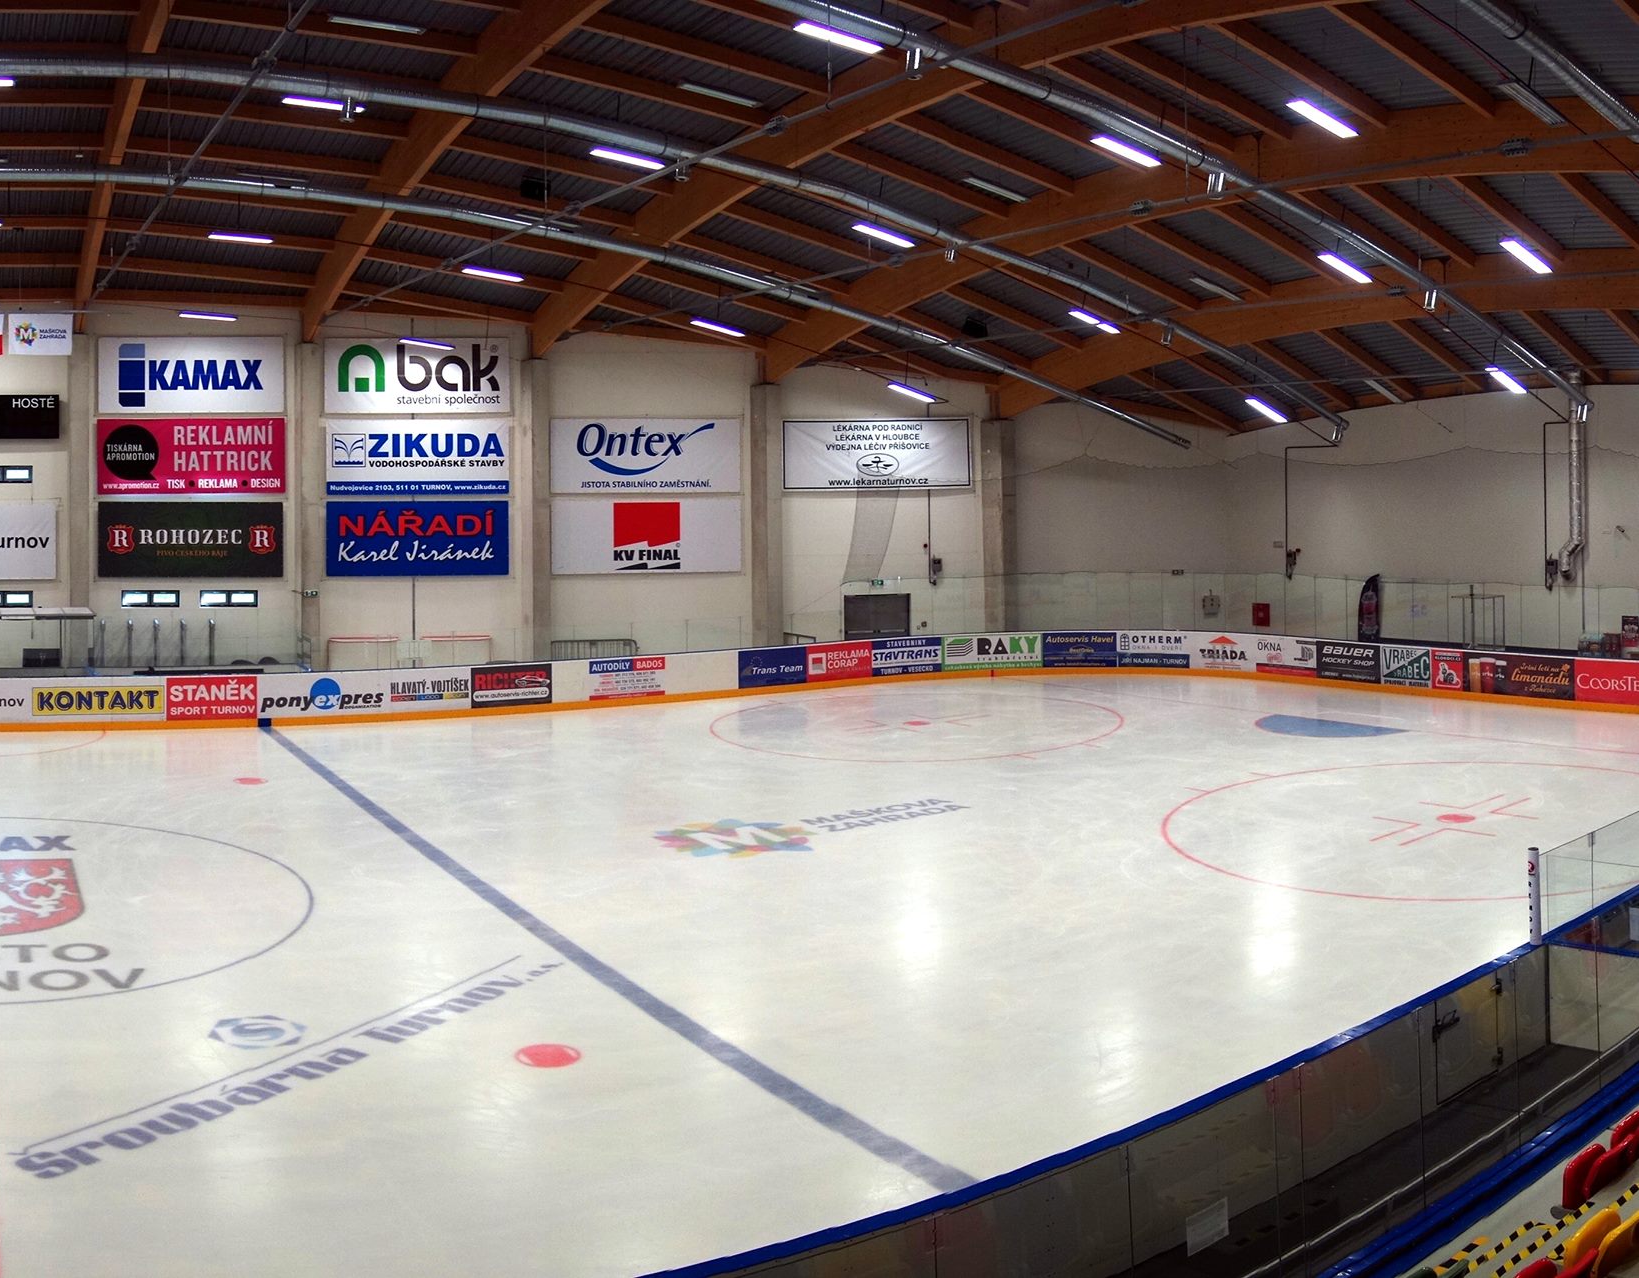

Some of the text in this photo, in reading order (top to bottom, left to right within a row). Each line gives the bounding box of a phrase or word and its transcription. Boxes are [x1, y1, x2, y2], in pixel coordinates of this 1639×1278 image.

[397, 343, 501, 392] bak
[149, 359, 263, 391] KAMAX
[12, 397, 55, 409] HOSTÉ
[444, 394, 500, 407] společnost
[173, 421, 273, 445] REKLAMNÍ
[832, 423, 923, 432] LÉKÁRNA POD RADNICÍ
[576, 422, 687, 457] Ontex
[835, 432, 874, 441] LÉKÁRNA
[882, 433, 920, 441] HLOUBCE
[106, 443, 143, 452] TISKÁRNA
[368, 433, 504, 458] ZIKUDA
[826, 441, 930, 451] VÝDEJNA LÉČIV PŘÍŠOVICE
[106, 452, 155, 461] APROMOTION
[173, 450, 273, 472] HATTRICK
[369, 458, 505, 468] VODOHOSPODÁŘSKÉ STAVBY
[103, 481, 160, 490] www.apromotion.cz
[167, 478, 281, 489] TISK REKLAMA DESIGN
[330, 484, 373, 492] Nudvojovice
[375, 484, 394, 492] 2103,
[421, 484, 453, 492] TURNOV,
[580, 479, 712, 489] JISTOTA STABILNÍHO ZAMĚSTNÁNÍ.
[828, 477, 929, 487] www.lekarnaturnov.cz
[338, 510, 494, 537] NÁŘADÍ
[139, 529, 243, 546] ROHOZEC
[338, 541, 494, 562] Karel Jiránek
[613, 549, 681, 561] KV FINAL
[977, 636, 1038, 656] RAKY
[1132, 636, 1182, 645] OTHERM
[1257, 641, 1282, 652] OKNA
[827, 649, 870, 660] REKLAMA
[873, 648, 940, 662] STAVTRANS
[592, 660, 662, 672] AUTODÍLY BADOS
[827, 658, 858, 669] CORAP
[1321, 657, 1375, 667] HOCKEY SHOP
[752, 664, 803, 675] Trans Team
[907, 665, 934, 673] VESECKO
[1511, 668, 1570, 685] limonádu
[170, 679, 255, 702] STANĚK
[431, 677, 469, 692] VOJTÍŠEK
[38, 690, 159, 711] KONTAKT
[170, 705, 255, 715] SPORT TURNOV
[800, 798, 953, 825] MAŠKOVA
[818, 804, 971, 832] ZAHRADA
[8, 1047, 369, 1179] Šroubárna
